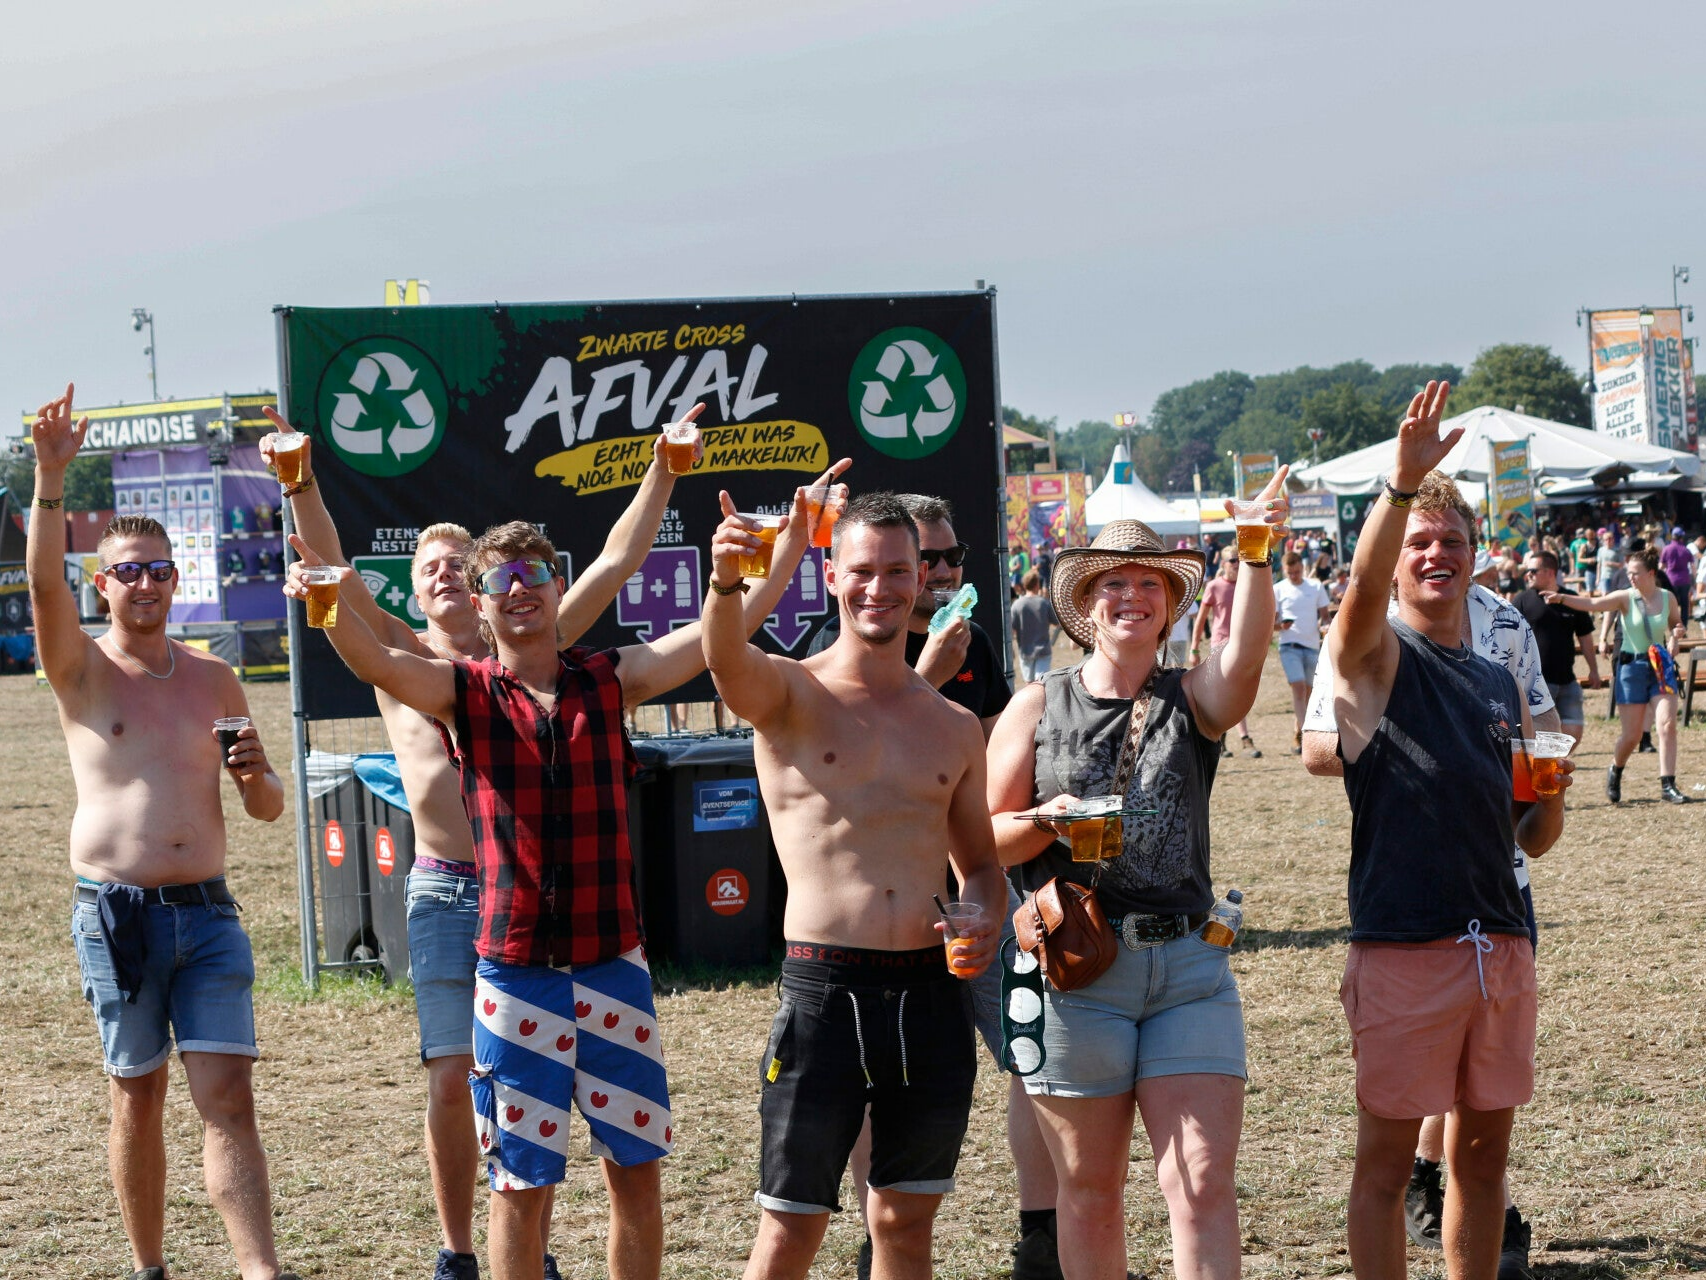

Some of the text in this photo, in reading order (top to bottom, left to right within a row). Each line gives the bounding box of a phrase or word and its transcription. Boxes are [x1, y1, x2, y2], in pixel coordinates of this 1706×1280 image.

[577, 324, 746, 361] ZWARTE CROSS
[1602, 371, 1637, 392] ZONDER
[504, 343, 779, 454] AFVAL
[1606, 399, 1635, 416] LOOPT
[1606, 412, 1635, 430] ALLES
[82, 414, 197, 448] CHANDISE
[594, 440, 644, 467] ÉCHT
[752, 425, 796, 444] WAS
[576, 467, 616, 490] NOG
[710, 442, 820, 467] MAKKELIJK!
[375, 527, 420, 540] ETENS
[675, 520, 685, 532] &
[371, 540, 417, 553] RESTE
[702, 799, 750, 809] EVENTSERVICE
